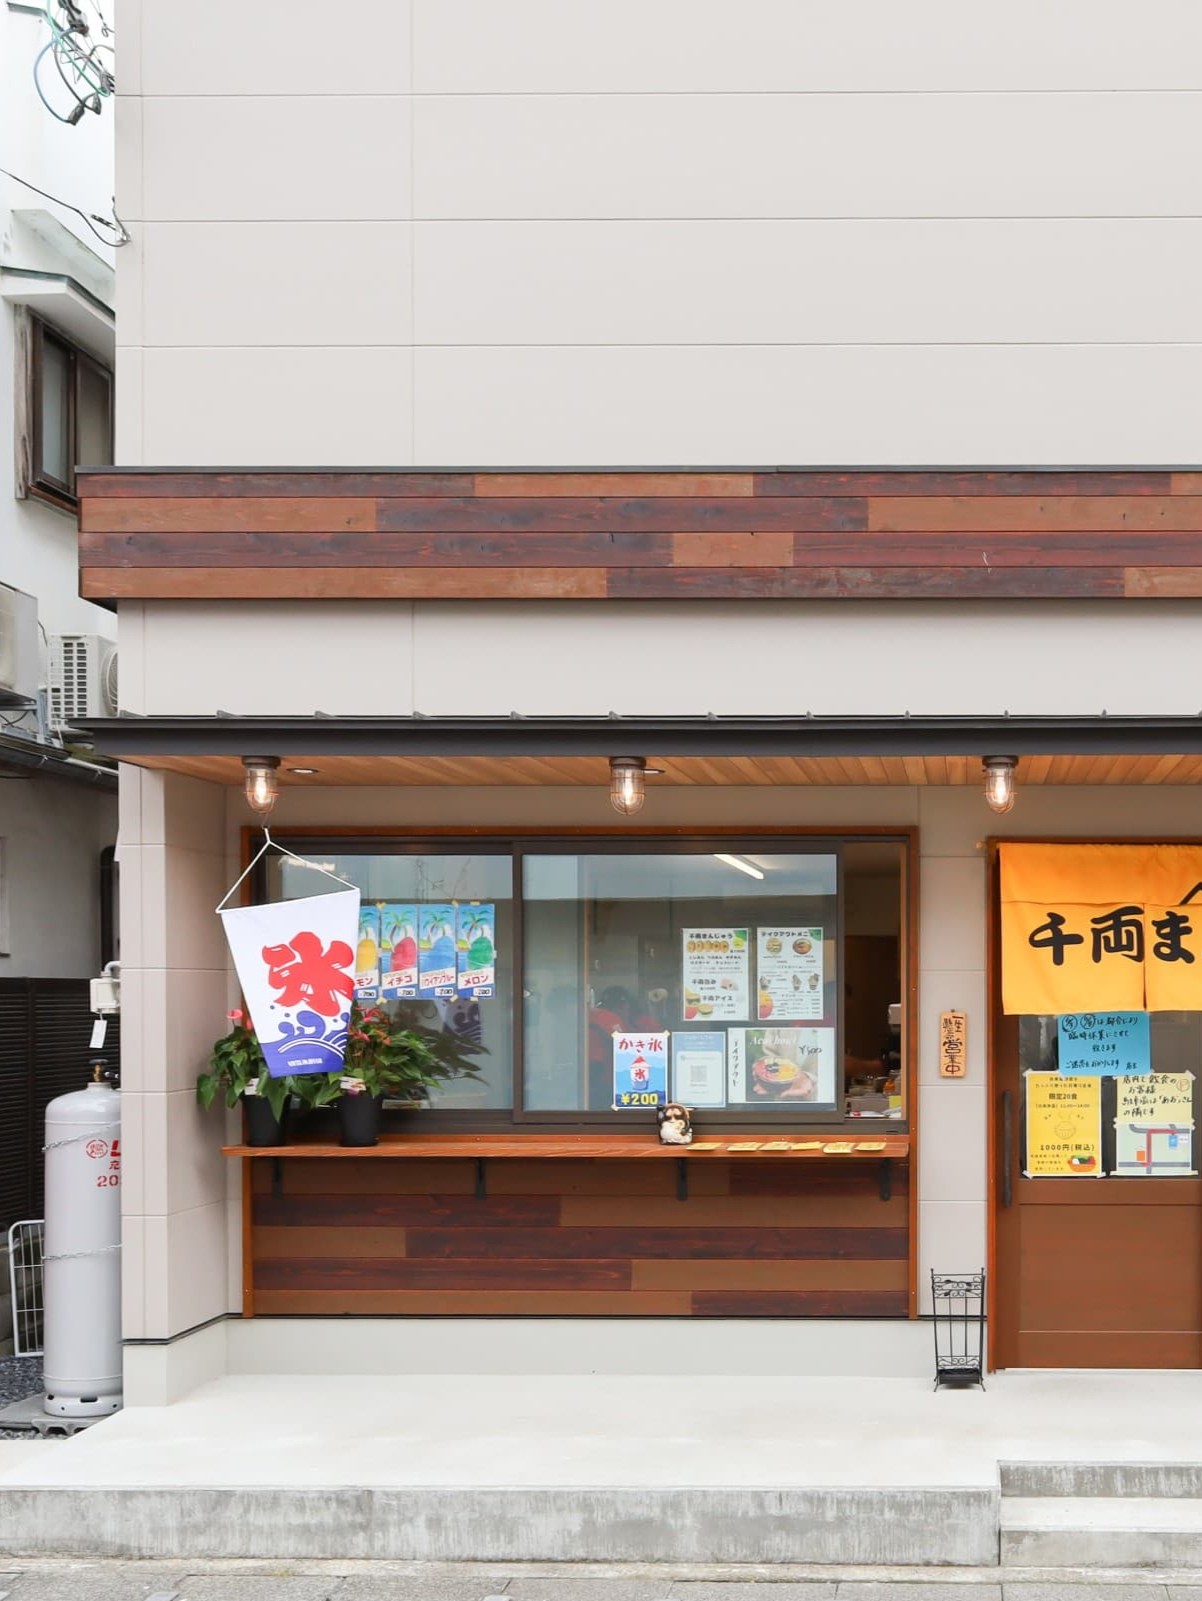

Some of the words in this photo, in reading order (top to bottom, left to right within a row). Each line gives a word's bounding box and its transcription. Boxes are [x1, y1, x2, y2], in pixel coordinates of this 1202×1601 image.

[262, 931, 357, 1018] 氷
[463, 975, 489, 987] メロン
[618, 1037, 664, 1053] かき氷
[621, 1093, 659, 1105] ¥200
[97, 1174, 121, 1187] 20
